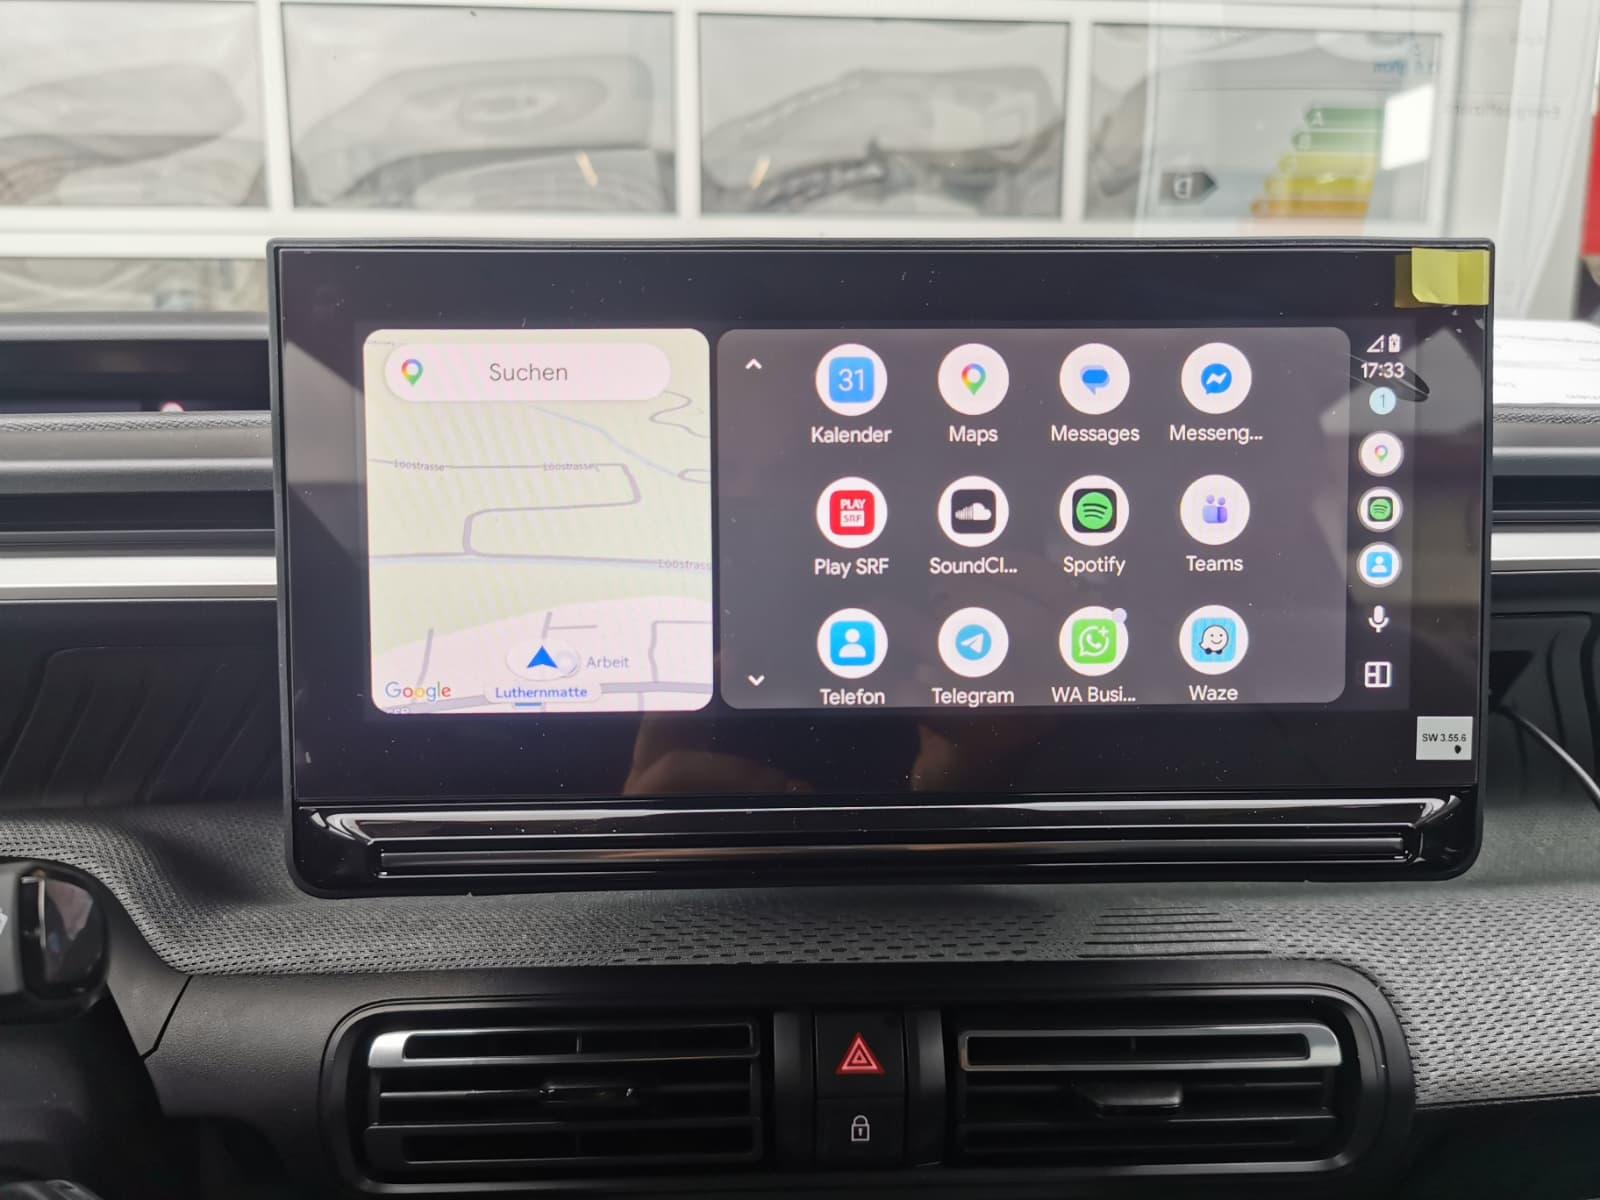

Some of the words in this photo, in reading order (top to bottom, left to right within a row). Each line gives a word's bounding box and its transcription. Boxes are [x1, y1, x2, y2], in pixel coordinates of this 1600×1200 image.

[489, 362, 568, 382] Suchen
[1360, 361, 1405, 379] 17:33
[837, 368, 865, 392] 31
[810, 426, 893, 444] Kalender
[949, 425, 999, 447] Maps
[1051, 424, 1141, 446] Messages
[1169, 423, 1264, 446] Messeng...
[393, 459, 446, 472] Loostrasse
[840, 498, 866, 510] PLAY
[843, 514, 863, 523] SRF
[813, 558, 851, 579] Play
[855, 557, 890, 575] SRF
[1063, 556, 1126, 577] Spotify
[1185, 555, 1244, 572] Teams
[586, 656, 629, 669] Arbeit
[384, 681, 451, 702] Google
[495, 686, 588, 699] Luthernmatte
[819, 688, 886, 705] Telefon
[931, 687, 1015, 708] Telegram
[1051, 687, 1083, 703] WA
[1087, 686, 1136, 703] Busi...
[1188, 685, 1239, 701] Waze
[1422, 733, 1438, 742] SW
[1440, 733, 1467, 742] 3.55.6
